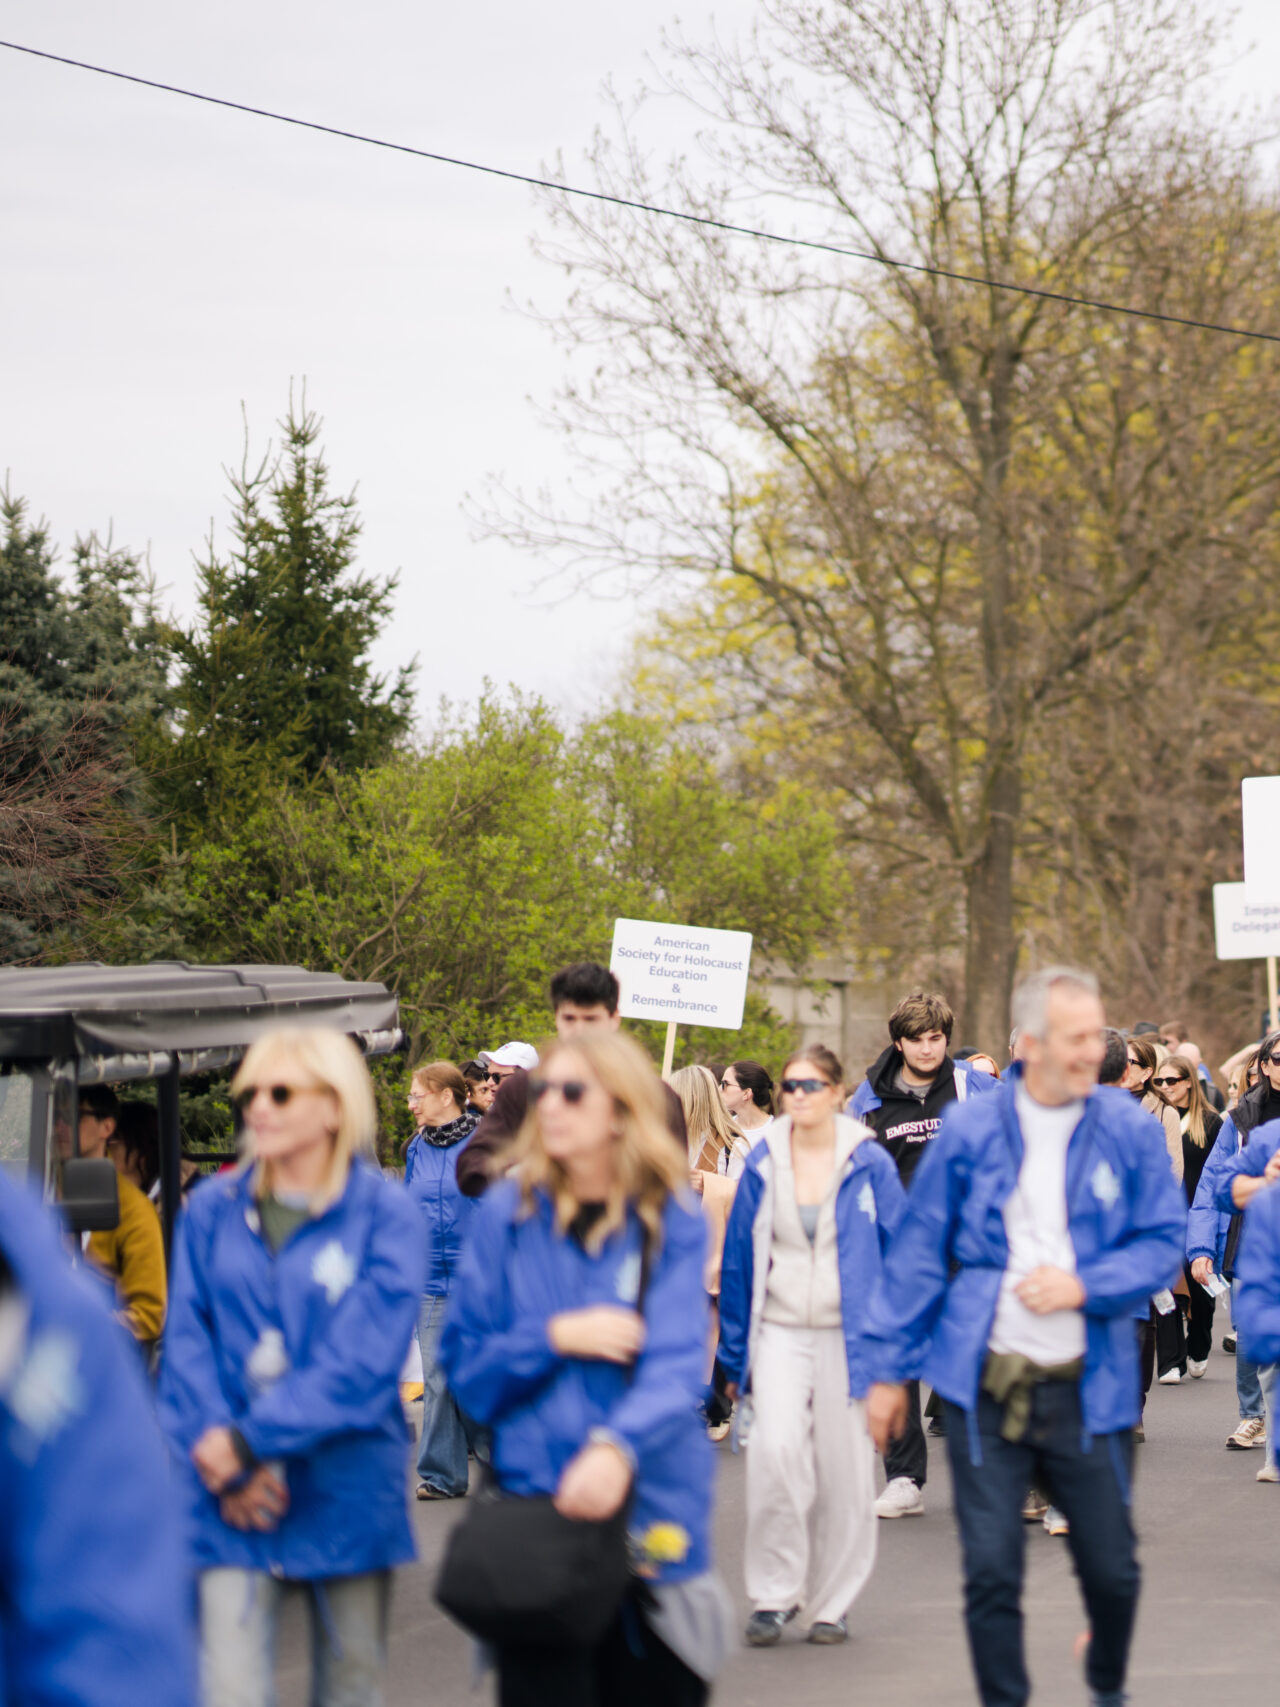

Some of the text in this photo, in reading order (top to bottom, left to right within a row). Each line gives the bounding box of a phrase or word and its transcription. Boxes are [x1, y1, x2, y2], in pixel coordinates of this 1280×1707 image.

[653, 936, 710, 952] American
[617, 947, 743, 970] Society for Holocaust
[649, 966, 708, 982] Education
[671, 983, 681, 994] &
[632, 993, 718, 1013] Remembrance
[886, 1118, 943, 1140] EMESTUD
